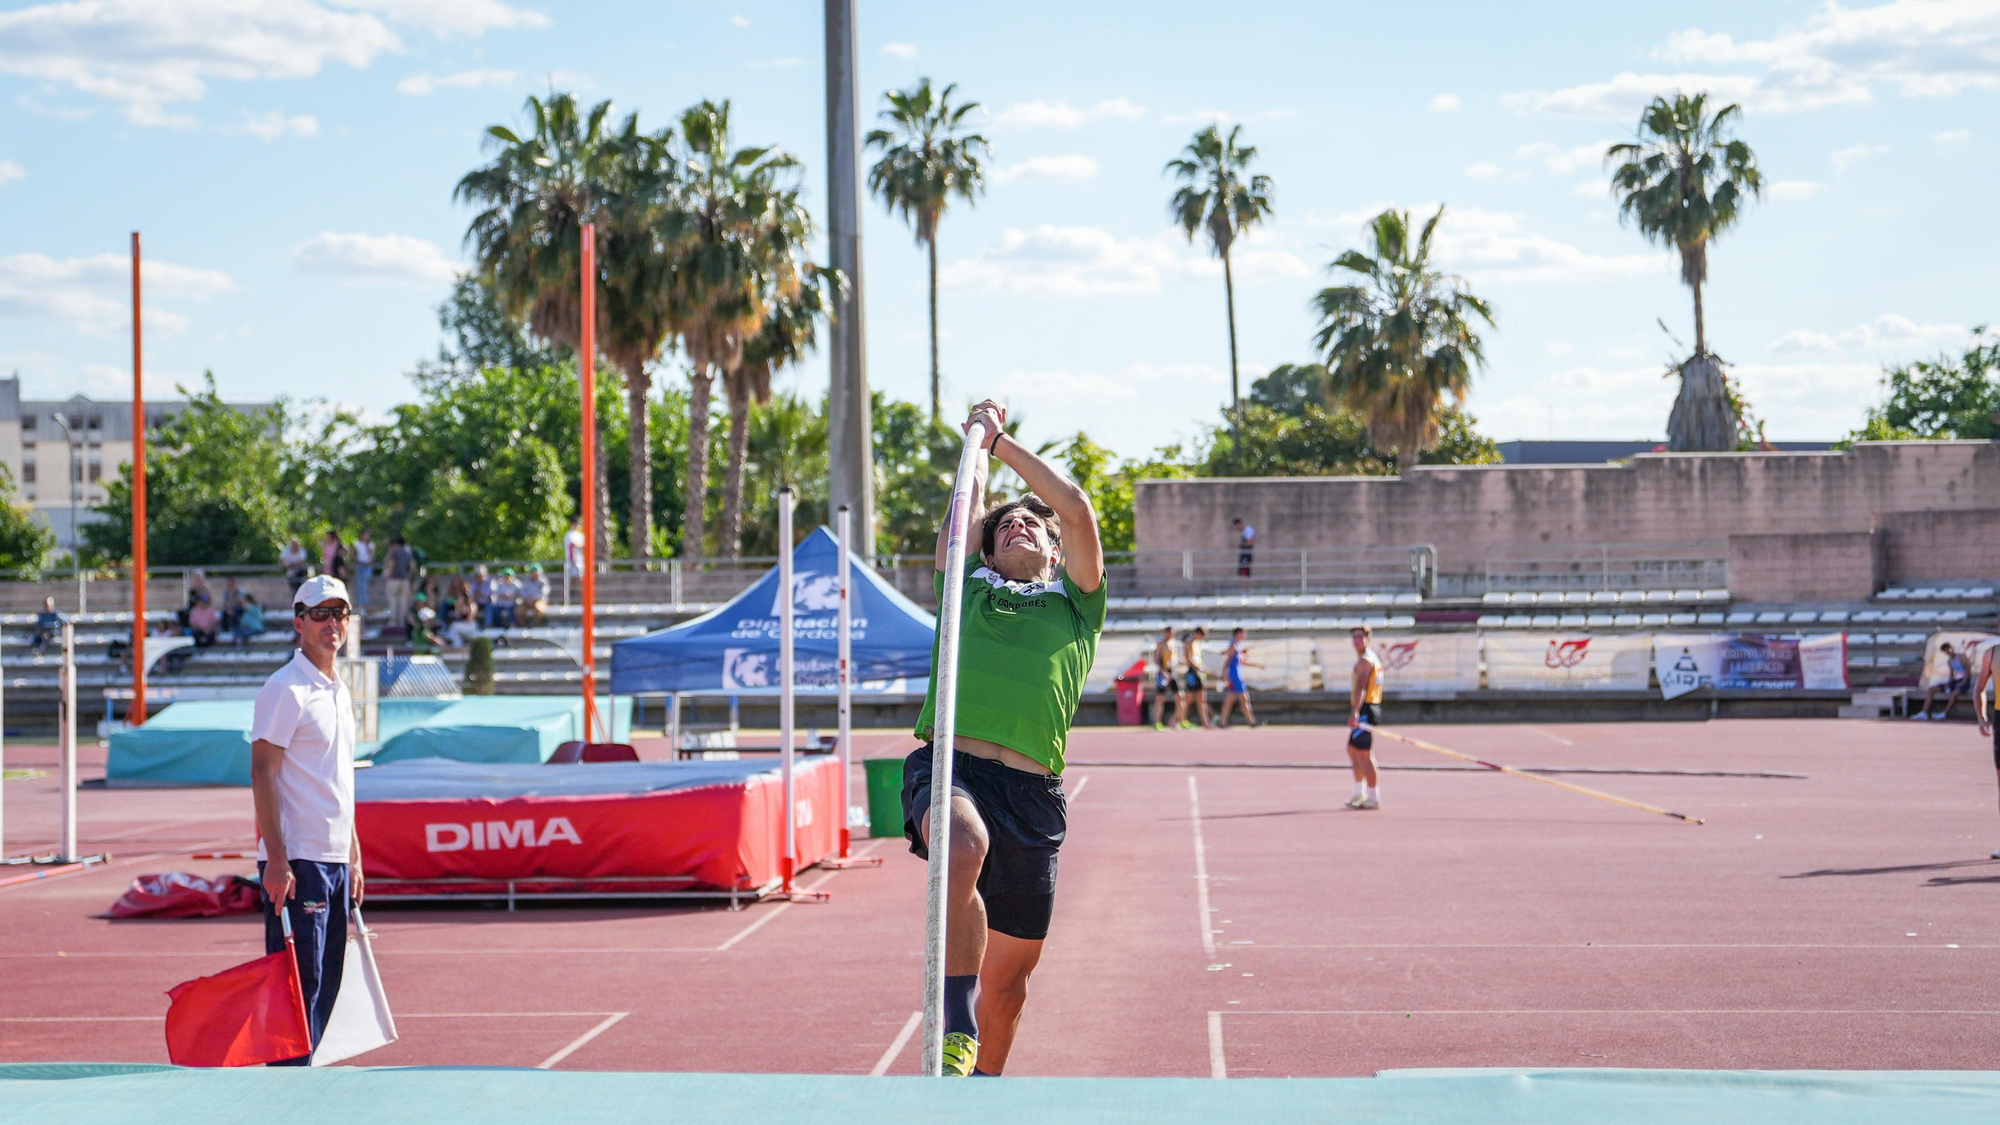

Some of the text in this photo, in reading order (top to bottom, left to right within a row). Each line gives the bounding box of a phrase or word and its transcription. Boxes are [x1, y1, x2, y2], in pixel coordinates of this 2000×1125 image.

[997, 598, 1047, 611] CORDOBÉS
[737, 617, 868, 631] Diptacin
[731, 628, 865, 640] de Crdoa
[425, 816, 582, 853] DIMA
